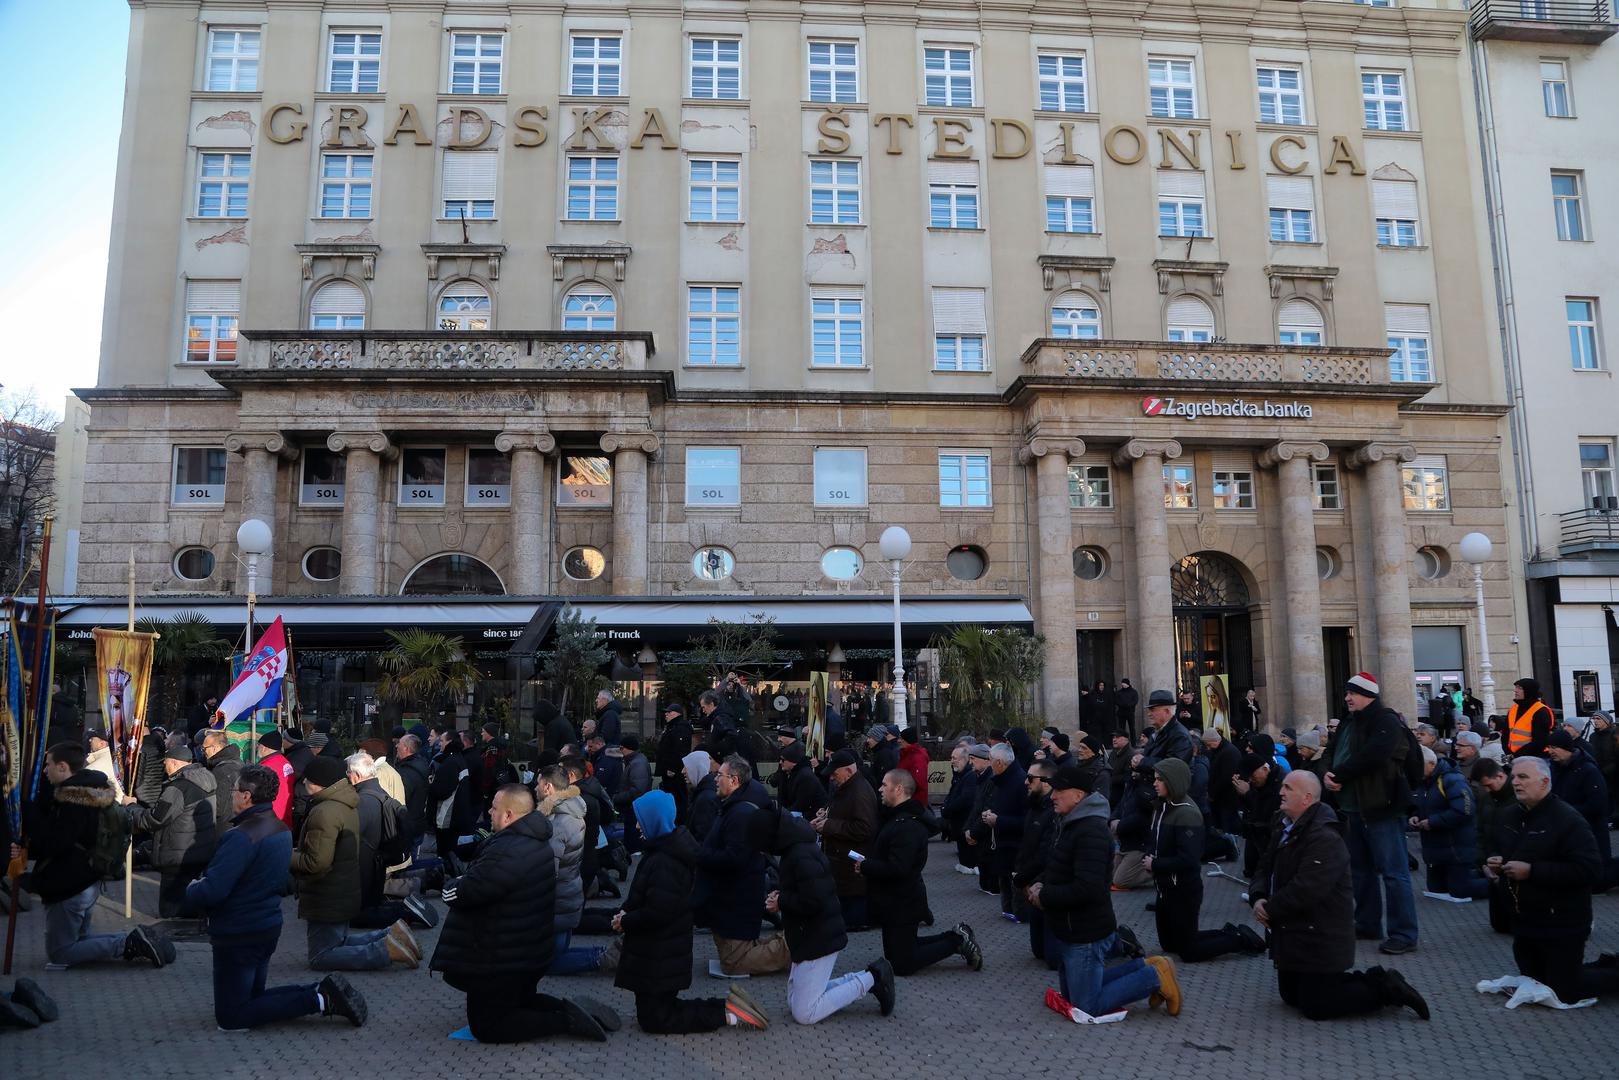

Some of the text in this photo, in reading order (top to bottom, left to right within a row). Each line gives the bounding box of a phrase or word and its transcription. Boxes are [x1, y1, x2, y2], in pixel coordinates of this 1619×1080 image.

[262, 103, 1366, 176] GRADSKA ŠTEDIONICA
[352, 391, 535, 409] GRADSKA KAVANA
[1164, 397, 1313, 420] Zagrebačka banka
[189, 489, 211, 498] SOL
[316, 489, 339, 498] SOL
[411, 489, 434, 498] SOL
[478, 489, 501, 498] SOL
[574, 489, 596, 498] SOL
[702, 489, 724, 498] SOL
[829, 490, 851, 499] SOL
[68, 630, 94, 638] Joha
[483, 629, 507, 638] since
[609, 629, 641, 639] Franck
